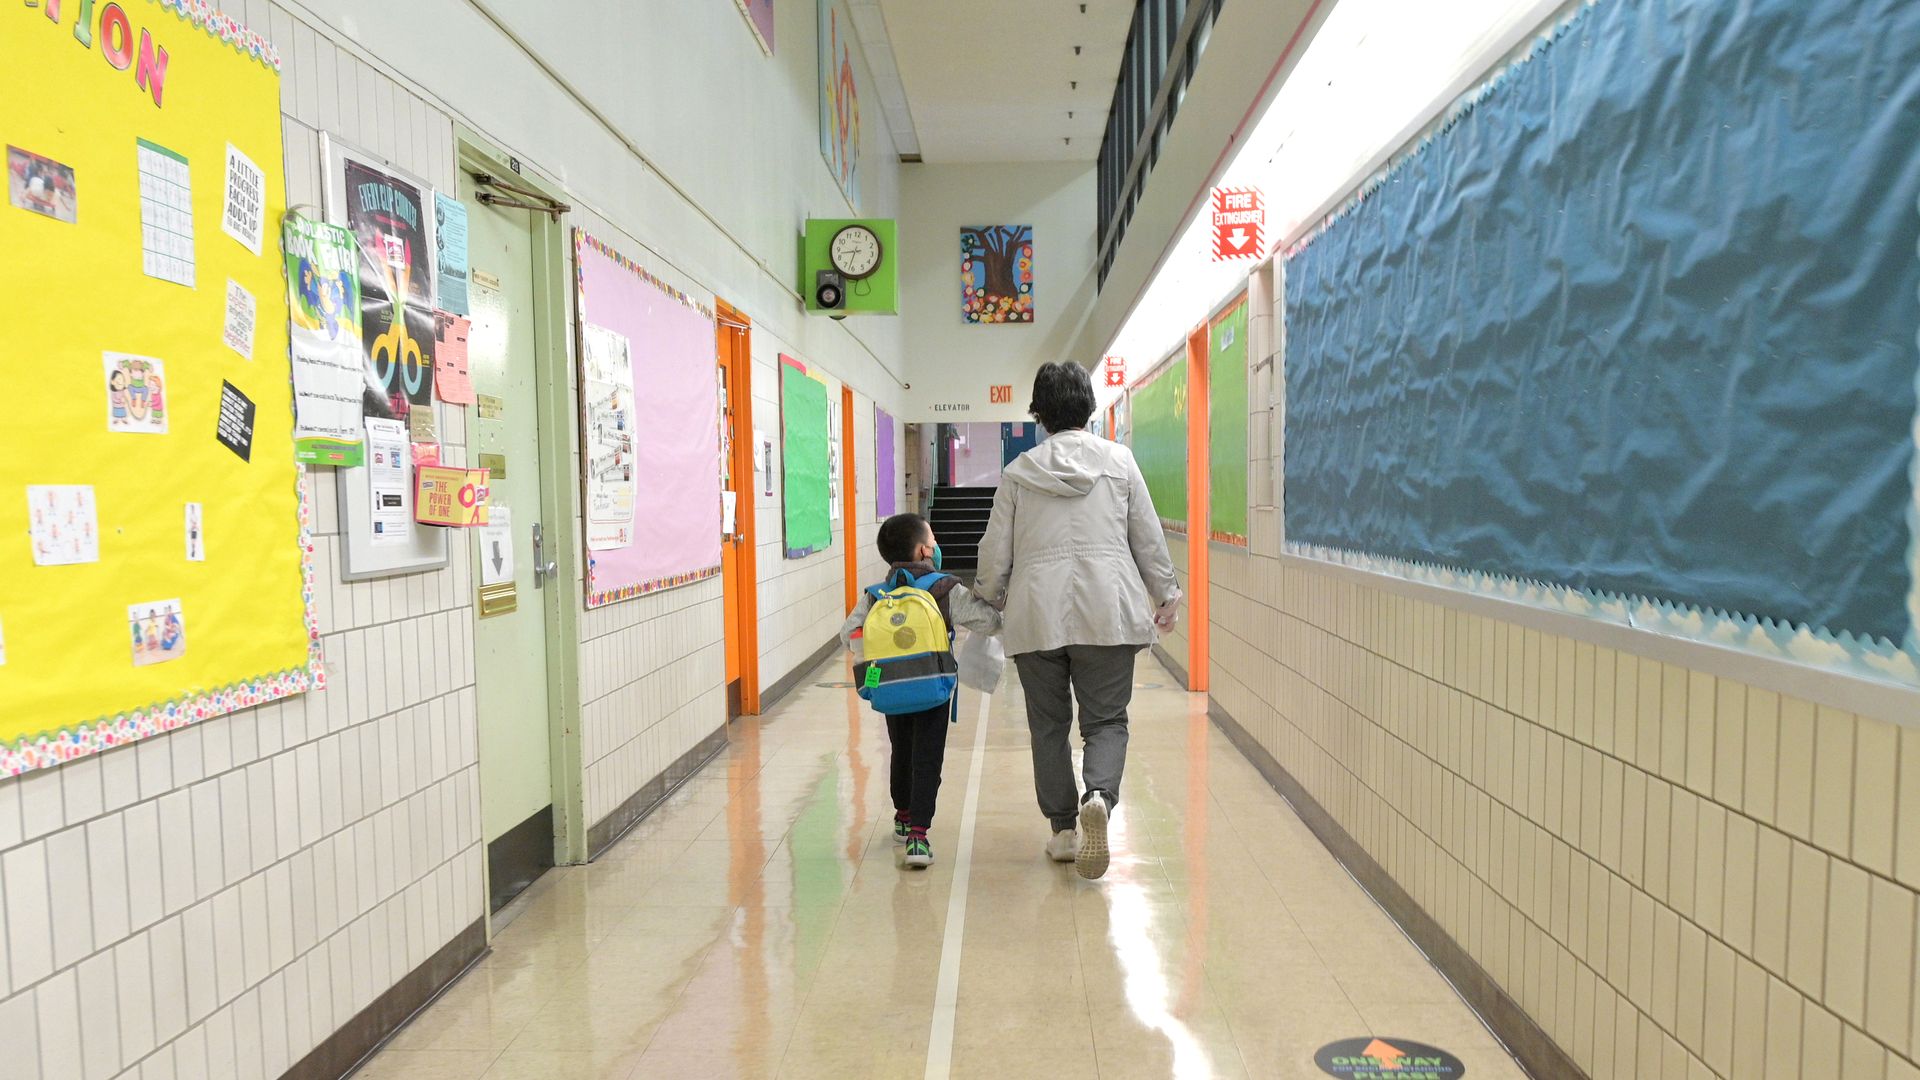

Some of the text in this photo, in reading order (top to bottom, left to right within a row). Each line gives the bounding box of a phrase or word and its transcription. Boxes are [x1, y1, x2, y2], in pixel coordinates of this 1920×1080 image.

[230, 155, 258, 190] A LITTLE
[230, 169, 258, 204] PROGRESS
[229, 184, 259, 219] EACH DAY
[358, 182, 380, 212] EVERY
[1225, 193, 1253, 209] FIRE
[227, 201, 258, 234] ADDS UP
[1214, 210, 1263, 226] EXTINGUISHER
[838, 238, 847, 246] 10
[854, 231, 862, 239] 12
[286, 226, 319, 266] BOOK
[990, 385, 1012, 403] EXIT
[934, 404, 970, 412] ELEVATOR
[435, 481, 449, 494] THE
[429, 492, 452, 506] POWER
[428, 505, 450, 518] OF ONE
[1331, 1056, 1441, 1066] ONE WAY
